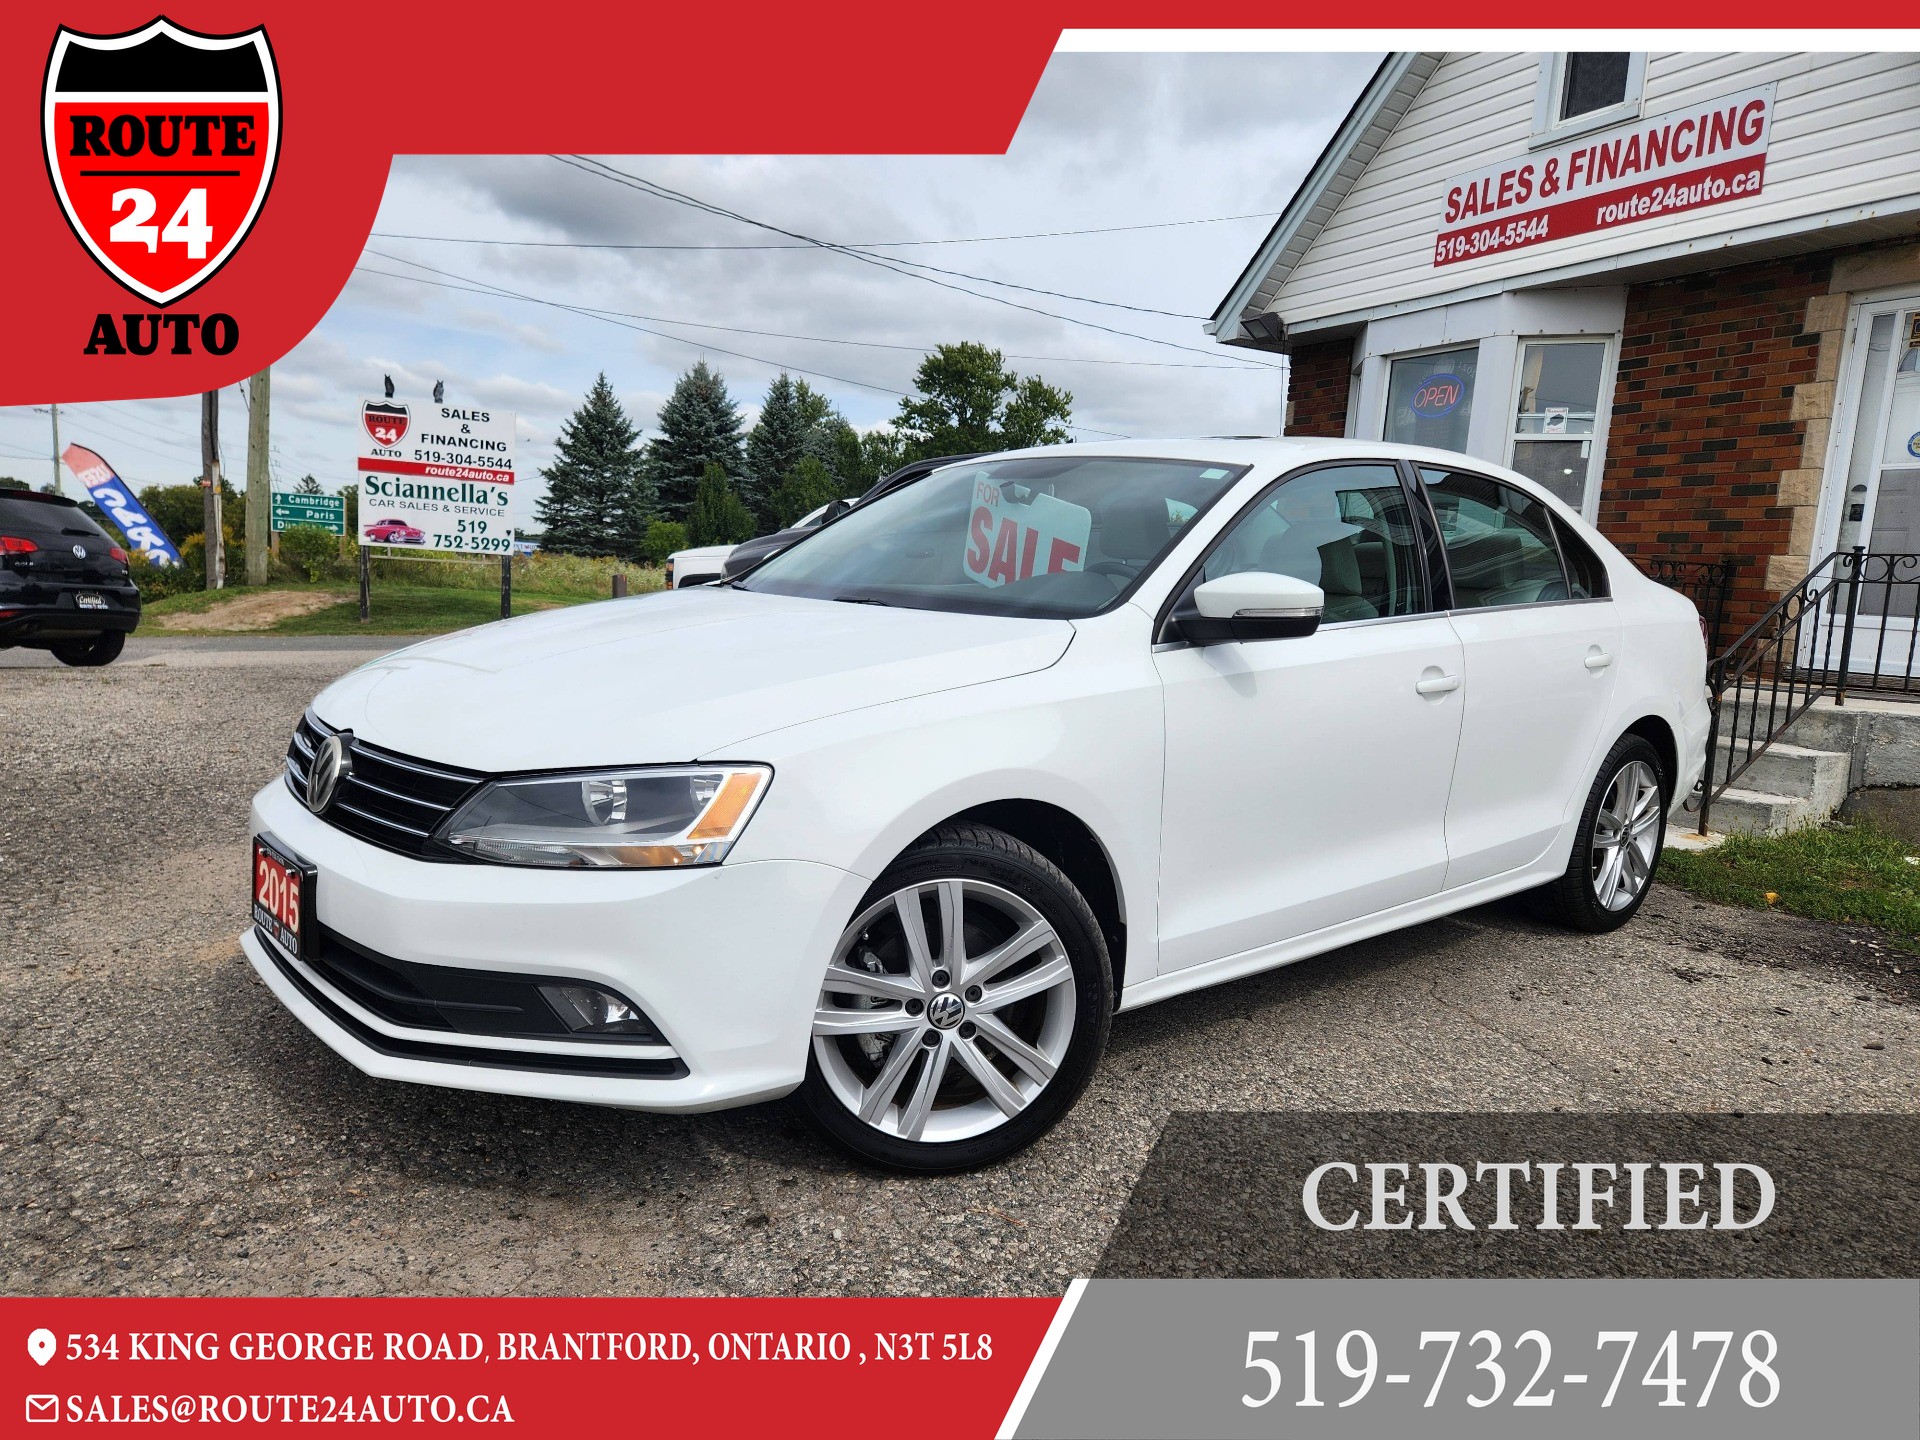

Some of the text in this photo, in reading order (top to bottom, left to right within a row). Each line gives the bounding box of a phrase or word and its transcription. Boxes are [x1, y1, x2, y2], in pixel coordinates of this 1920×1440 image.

[1444, 99, 1766, 224] SALES & FINANCING
[1596, 169, 1761, 225] route24auto.ca
[1436, 215, 1549, 262] 519-304-5544
[1414, 384, 1460, 408] OPEN
[368, 414, 406, 426] ROUTE
[441, 408, 490, 422] SALES
[375, 427, 397, 442] 24
[460, 424, 471, 434] &
[421, 434, 507, 452] FINANCING
[371, 448, 402, 458] AUTO
[414, 450, 512, 470] 519-304-5544
[425, 466, 510, 482] route24auto.ca
[365, 475, 509, 506] Sciannella's
[976, 481, 1000, 507] FOR
[288, 495, 340, 508] Cambridge
[369, 499, 505, 517] CAR SALES & SERVICE
[306, 510, 335, 520] Paris
[457, 519, 488, 534] 519
[433, 534, 511, 551] 752-5299
[259, 861, 299, 934] 2015
[253, 903, 298, 954] ROUTE AUTO
